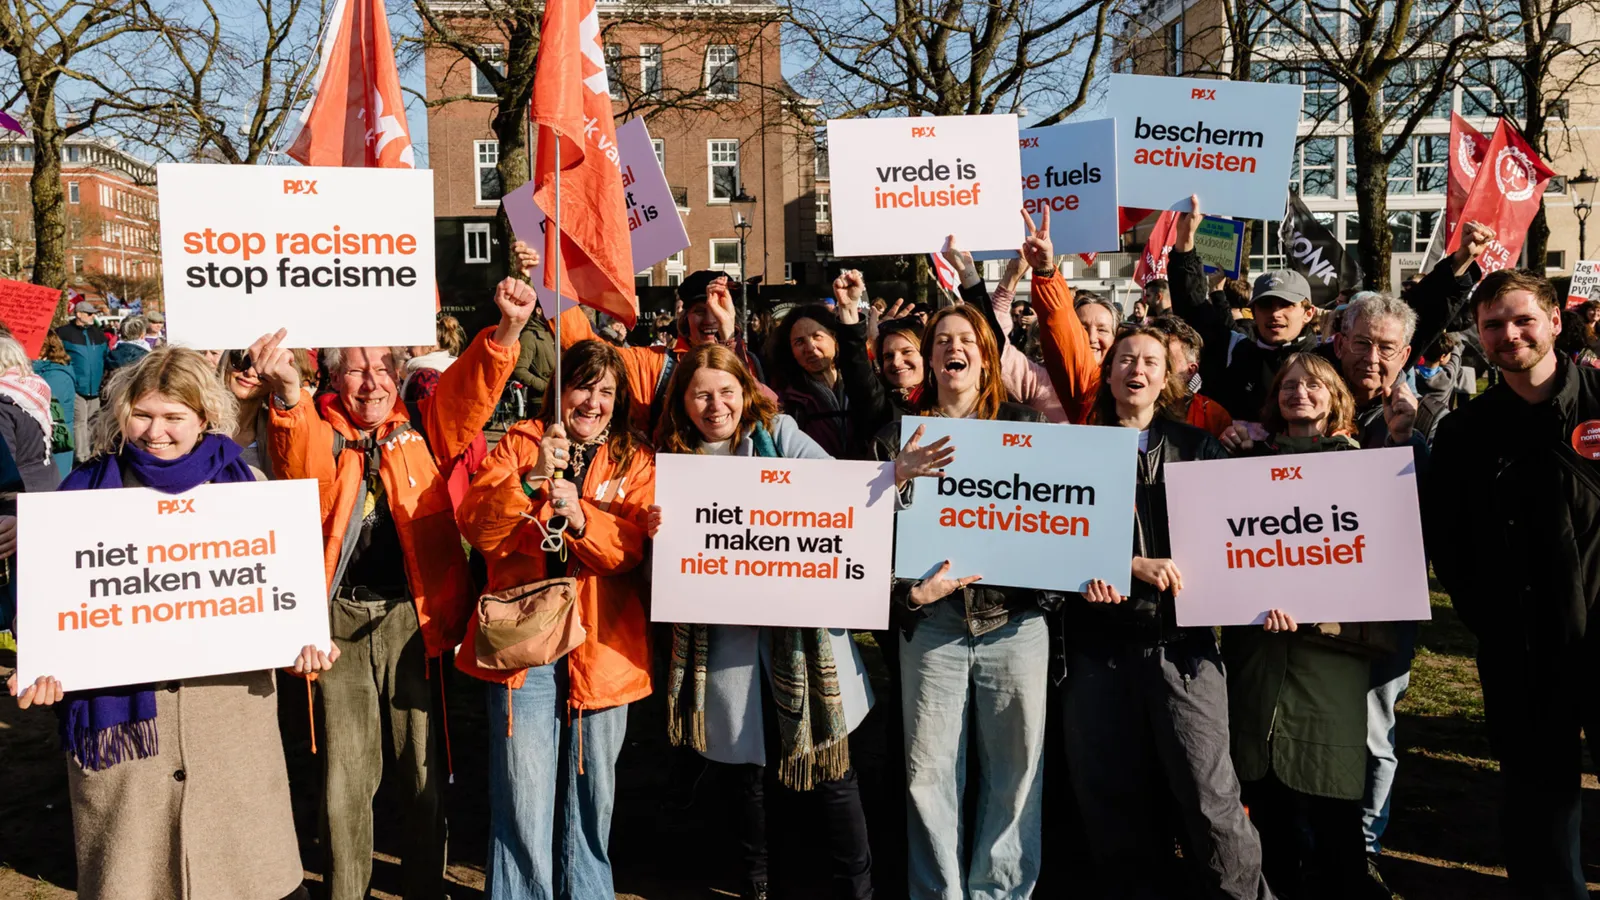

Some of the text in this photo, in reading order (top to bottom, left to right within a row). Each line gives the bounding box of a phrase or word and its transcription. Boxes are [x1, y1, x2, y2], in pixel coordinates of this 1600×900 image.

[1192, 89, 1216, 100] PAX
[912, 127, 935, 138] PAX
[1135, 117, 1263, 149] bescherm
[876, 158, 976, 183] vrede is
[1134, 145, 1256, 173] activisten
[284, 180, 317, 194] PAX
[1044, 162, 1102, 188] fuels
[875, 182, 980, 208] inclusief
[1023, 195, 1079, 215] ence
[642, 204, 658, 222] is
[184, 225, 417, 260] stop racisme
[186, 257, 416, 294] stop facisme
[1573, 275, 1598, 285] tegen
[1576, 263, 1592, 274] Zeg
[1571, 286, 1590, 295] PVV
[1003, 434, 1032, 448] PAX
[761, 470, 790, 484] PAX
[1271, 467, 1302, 481] PAX
[938, 470, 1095, 506] bescherm
[157, 499, 195, 514] PAX
[696, 502, 853, 530] niet normaal
[940, 502, 1090, 537] activisten
[1226, 505, 1359, 537] vrede is
[75, 531, 275, 569] niet normaal
[705, 528, 843, 554] maken wat
[1226, 535, 1366, 568] inclusief
[681, 553, 865, 580] niet normaal is
[89, 562, 267, 598] maken wat
[57, 587, 297, 632] niet normaal is
